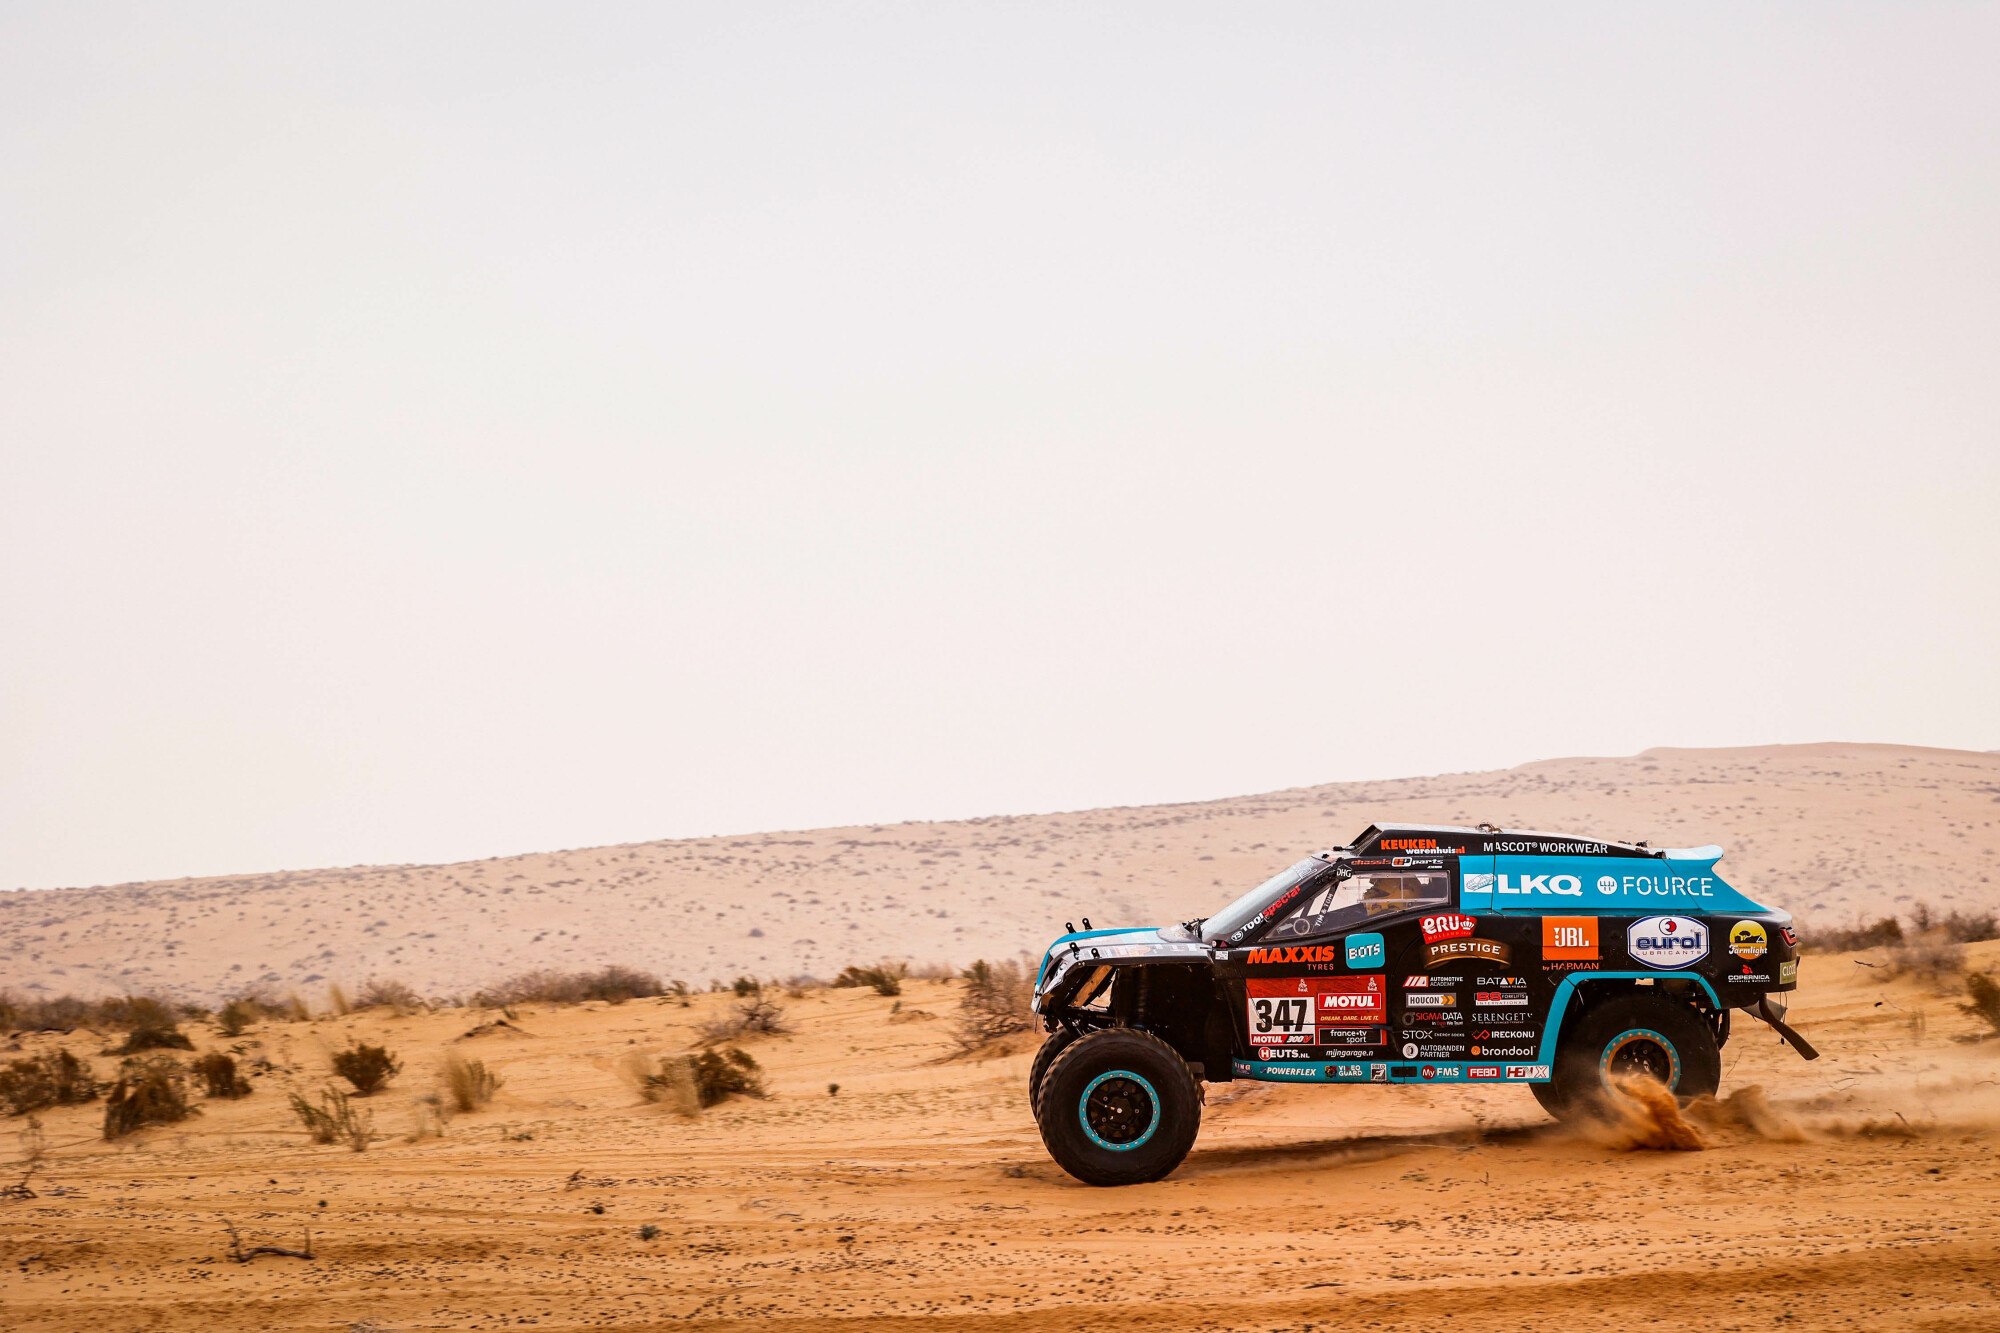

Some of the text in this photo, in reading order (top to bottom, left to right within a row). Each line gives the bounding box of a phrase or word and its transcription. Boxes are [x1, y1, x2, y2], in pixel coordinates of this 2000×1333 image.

[1380, 839, 1437, 850] KEUKEN
[1539, 842, 1608, 854] WORKWEAR
[1350, 858, 1392, 866] chassis
[1336, 869, 1352, 878] DHG
[1497, 874, 1584, 897] LKQ
[1622, 876, 1714, 897] FOURCE
[1553, 927, 1590, 947] JBL
[1636, 931, 1702, 950] eurol
[1348, 944, 1381, 960] BOTS
[1430, 943, 1502, 955] PRESTIGE
[1728, 944, 1768, 957] Farmlight
[1247, 946, 1335, 964] MAXXIS
[1551, 962, 1600, 970] HARMAN
[1476, 977, 1527, 985] BATAVIA
[1323, 995, 1375, 1008] MOTUL
[1409, 996, 1440, 1004] HOUCON
[1476, 992, 1502, 1001] BS
[1256, 999, 1307, 1033] 347
[1415, 1012, 1463, 1021] SIGMADATA
[1252, 1035, 1313, 1044] MOTUL 300V
[1402, 1030, 1433, 1040] STOX
[1491, 1030, 1535, 1039] IRECKONU
[1346, 1036, 1367, 1045] sport
[1419, 1044, 1465, 1052] AUTOBANDEN
[1481, 1045, 1534, 1056] brondool
[1260, 1048, 1310, 1059] HEUTS.NL
[1266, 1067, 1317, 1076] POWERFLEX
[1469, 1068, 1498, 1077] FEBO
